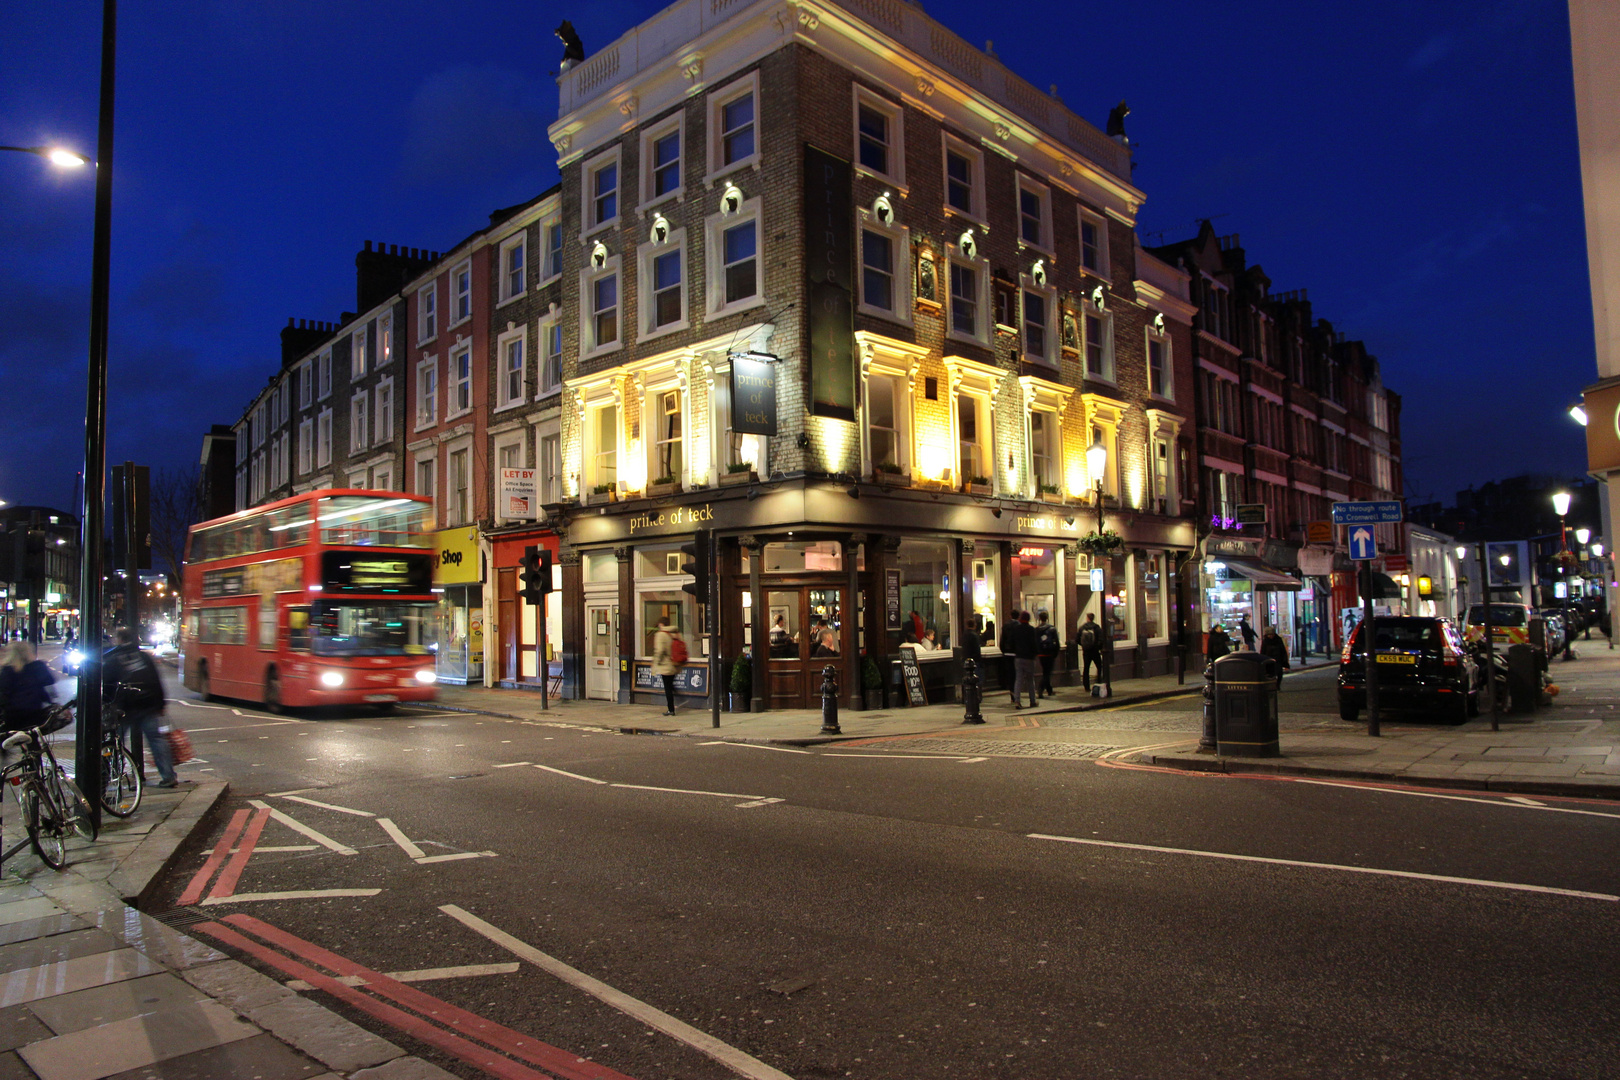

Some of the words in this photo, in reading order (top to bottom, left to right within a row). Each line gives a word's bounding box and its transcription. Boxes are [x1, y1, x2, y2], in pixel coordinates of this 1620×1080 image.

[737, 373, 774, 389] prince
[750, 391, 763, 404] of
[745, 410, 769, 424] teck
[504, 470, 520, 478] LET
[522, 471, 534, 479] BY
[670, 507, 683, 525] of
[688, 503, 714, 522] teck
[1349, 505, 1375, 513] through
[1017, 513, 1045, 532] prince
[1048, 516, 1057, 530] of
[1346, 513, 1379, 521] Cromwell
[442, 549, 463, 567] Shop
